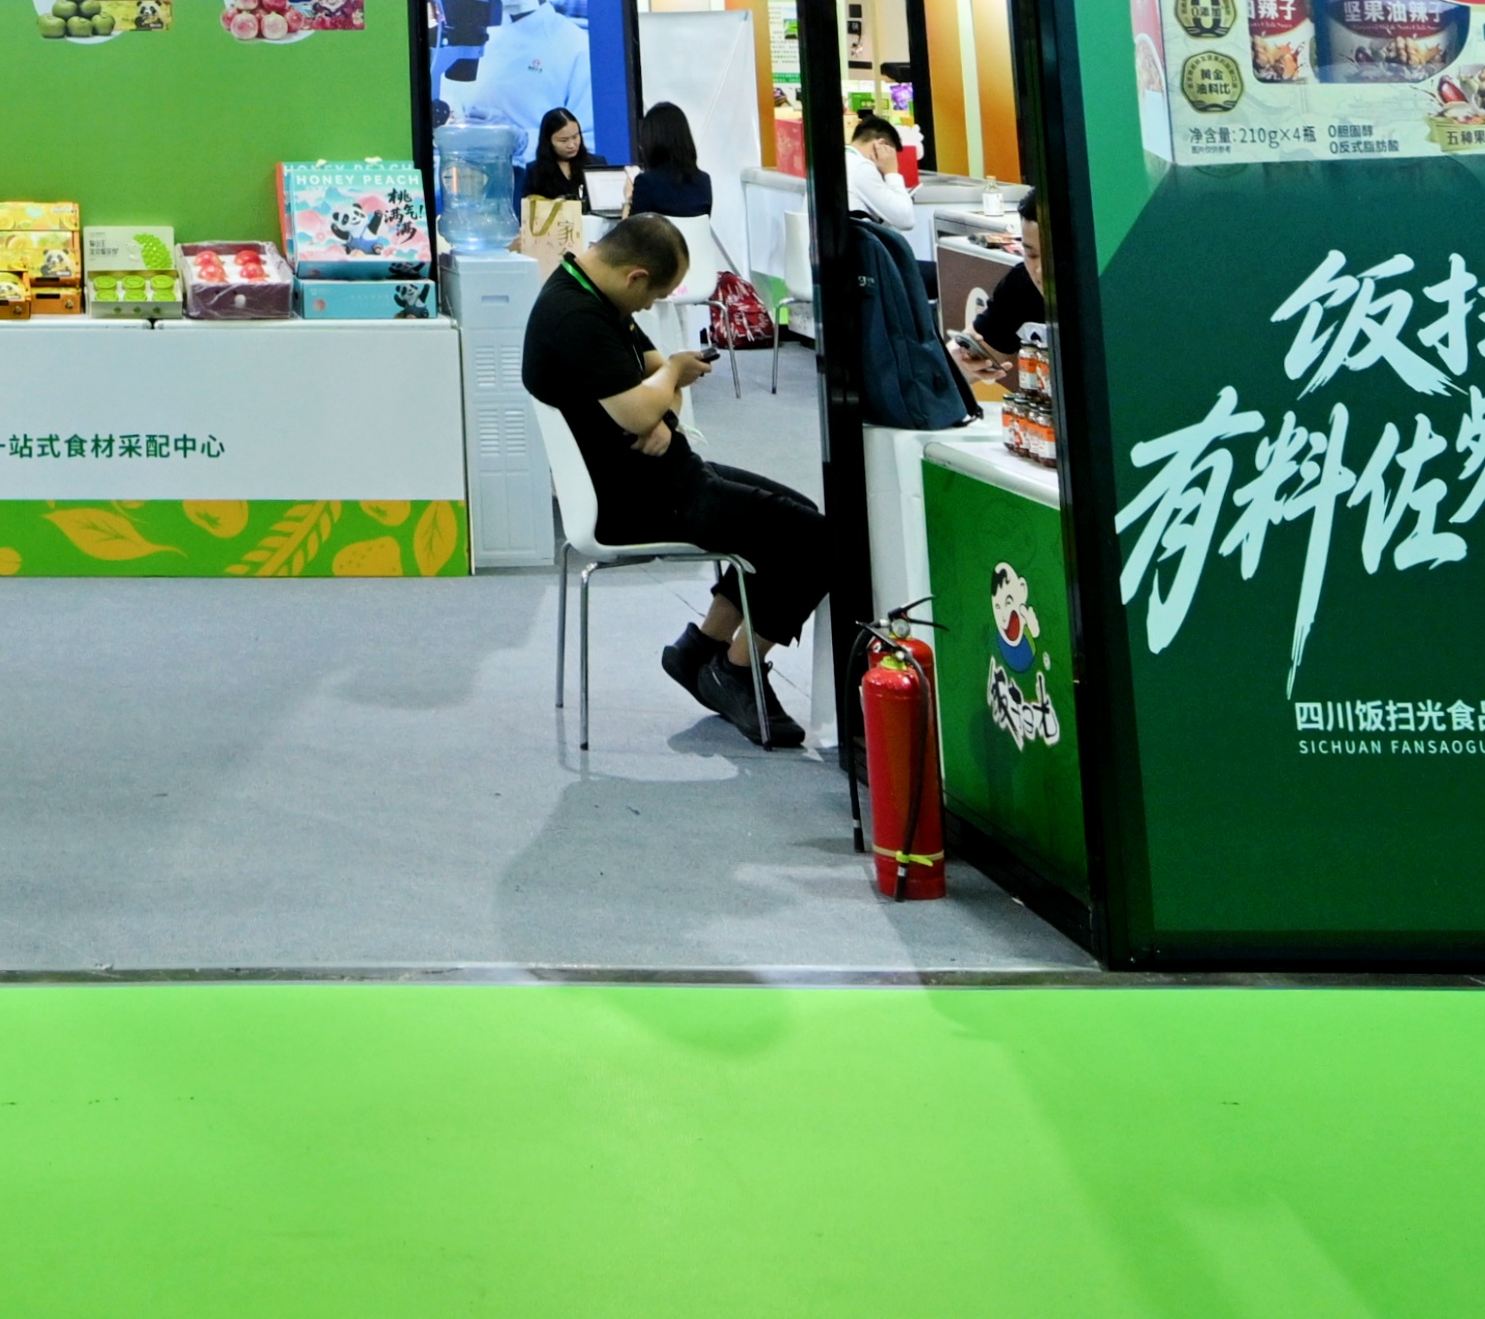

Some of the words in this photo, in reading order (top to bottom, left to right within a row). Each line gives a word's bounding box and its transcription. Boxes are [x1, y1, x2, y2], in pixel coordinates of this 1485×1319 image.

[296, 175, 355, 185] HONEY
[363, 175, 420, 186] PEACH
[1299, 739, 1383, 754] SICHUAN
